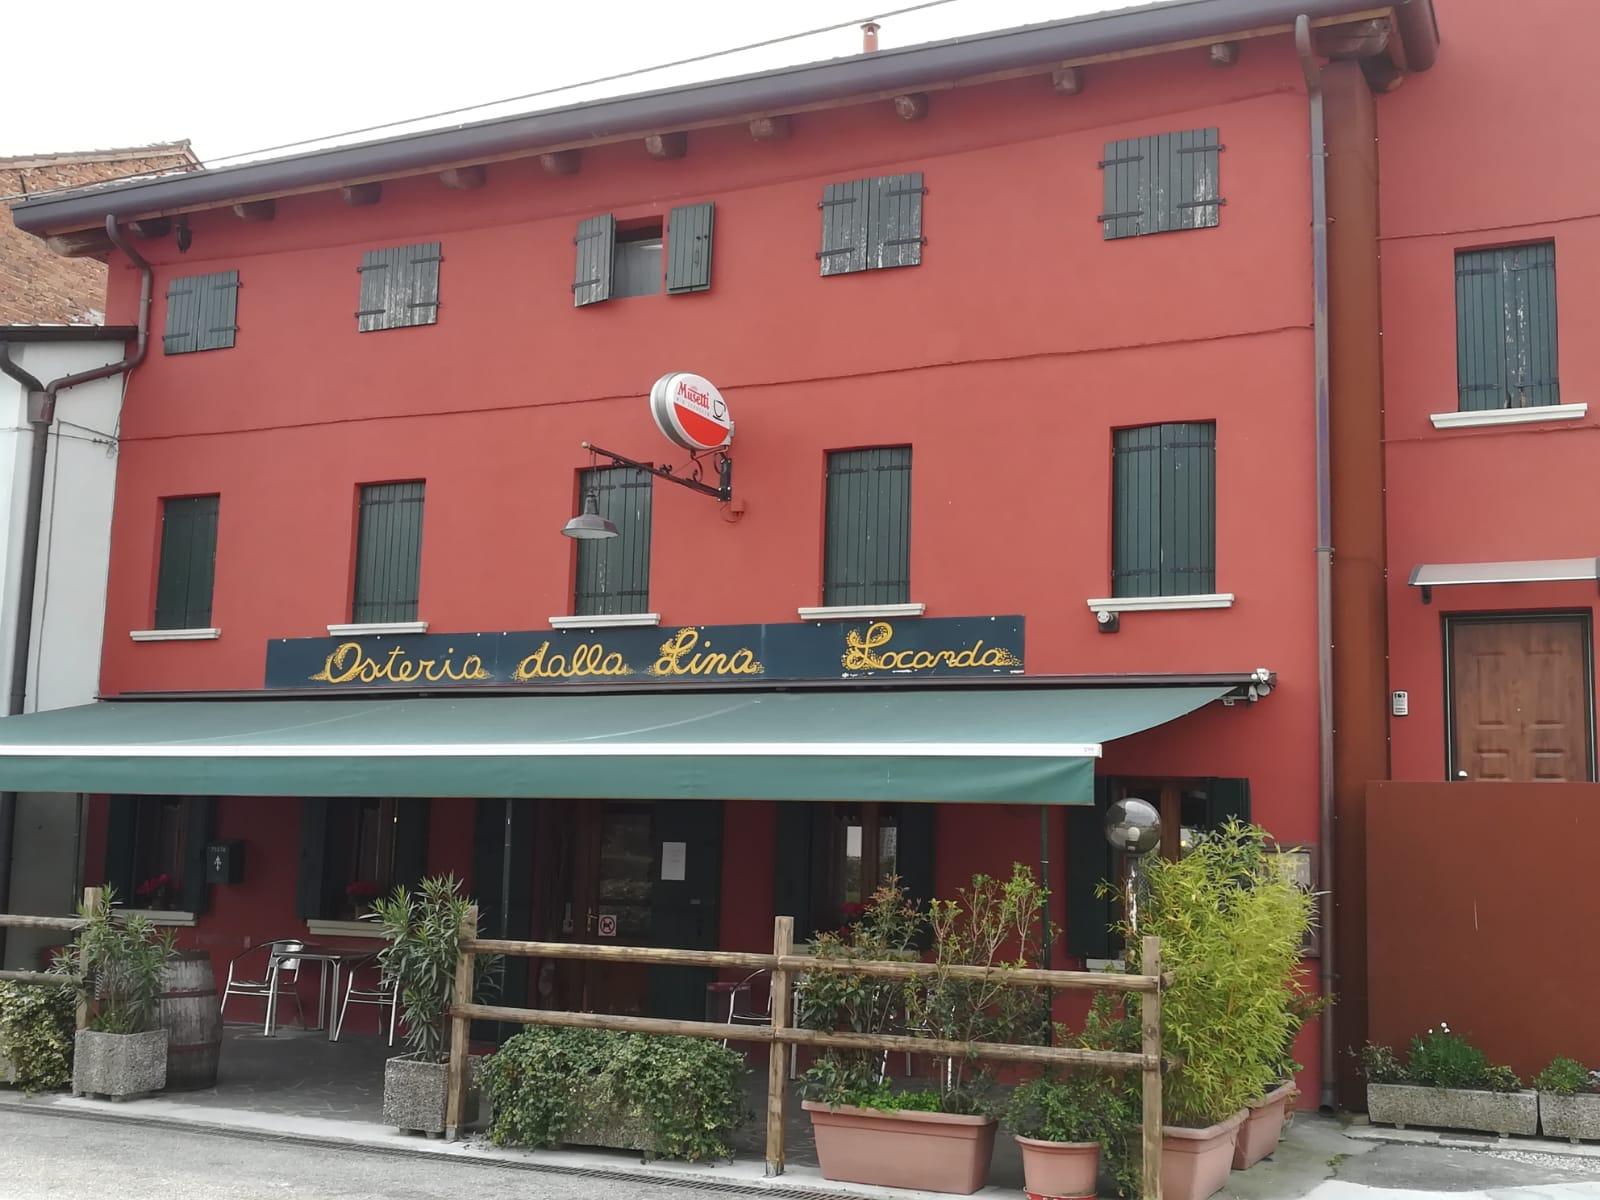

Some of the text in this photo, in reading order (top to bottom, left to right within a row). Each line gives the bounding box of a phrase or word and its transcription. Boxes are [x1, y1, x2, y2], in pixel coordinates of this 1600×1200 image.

[678, 382, 710, 410] Musetti
[312, 626, 762, 683] Osteria dalla Lina
[842, 622, 1018, 671] Locanda
